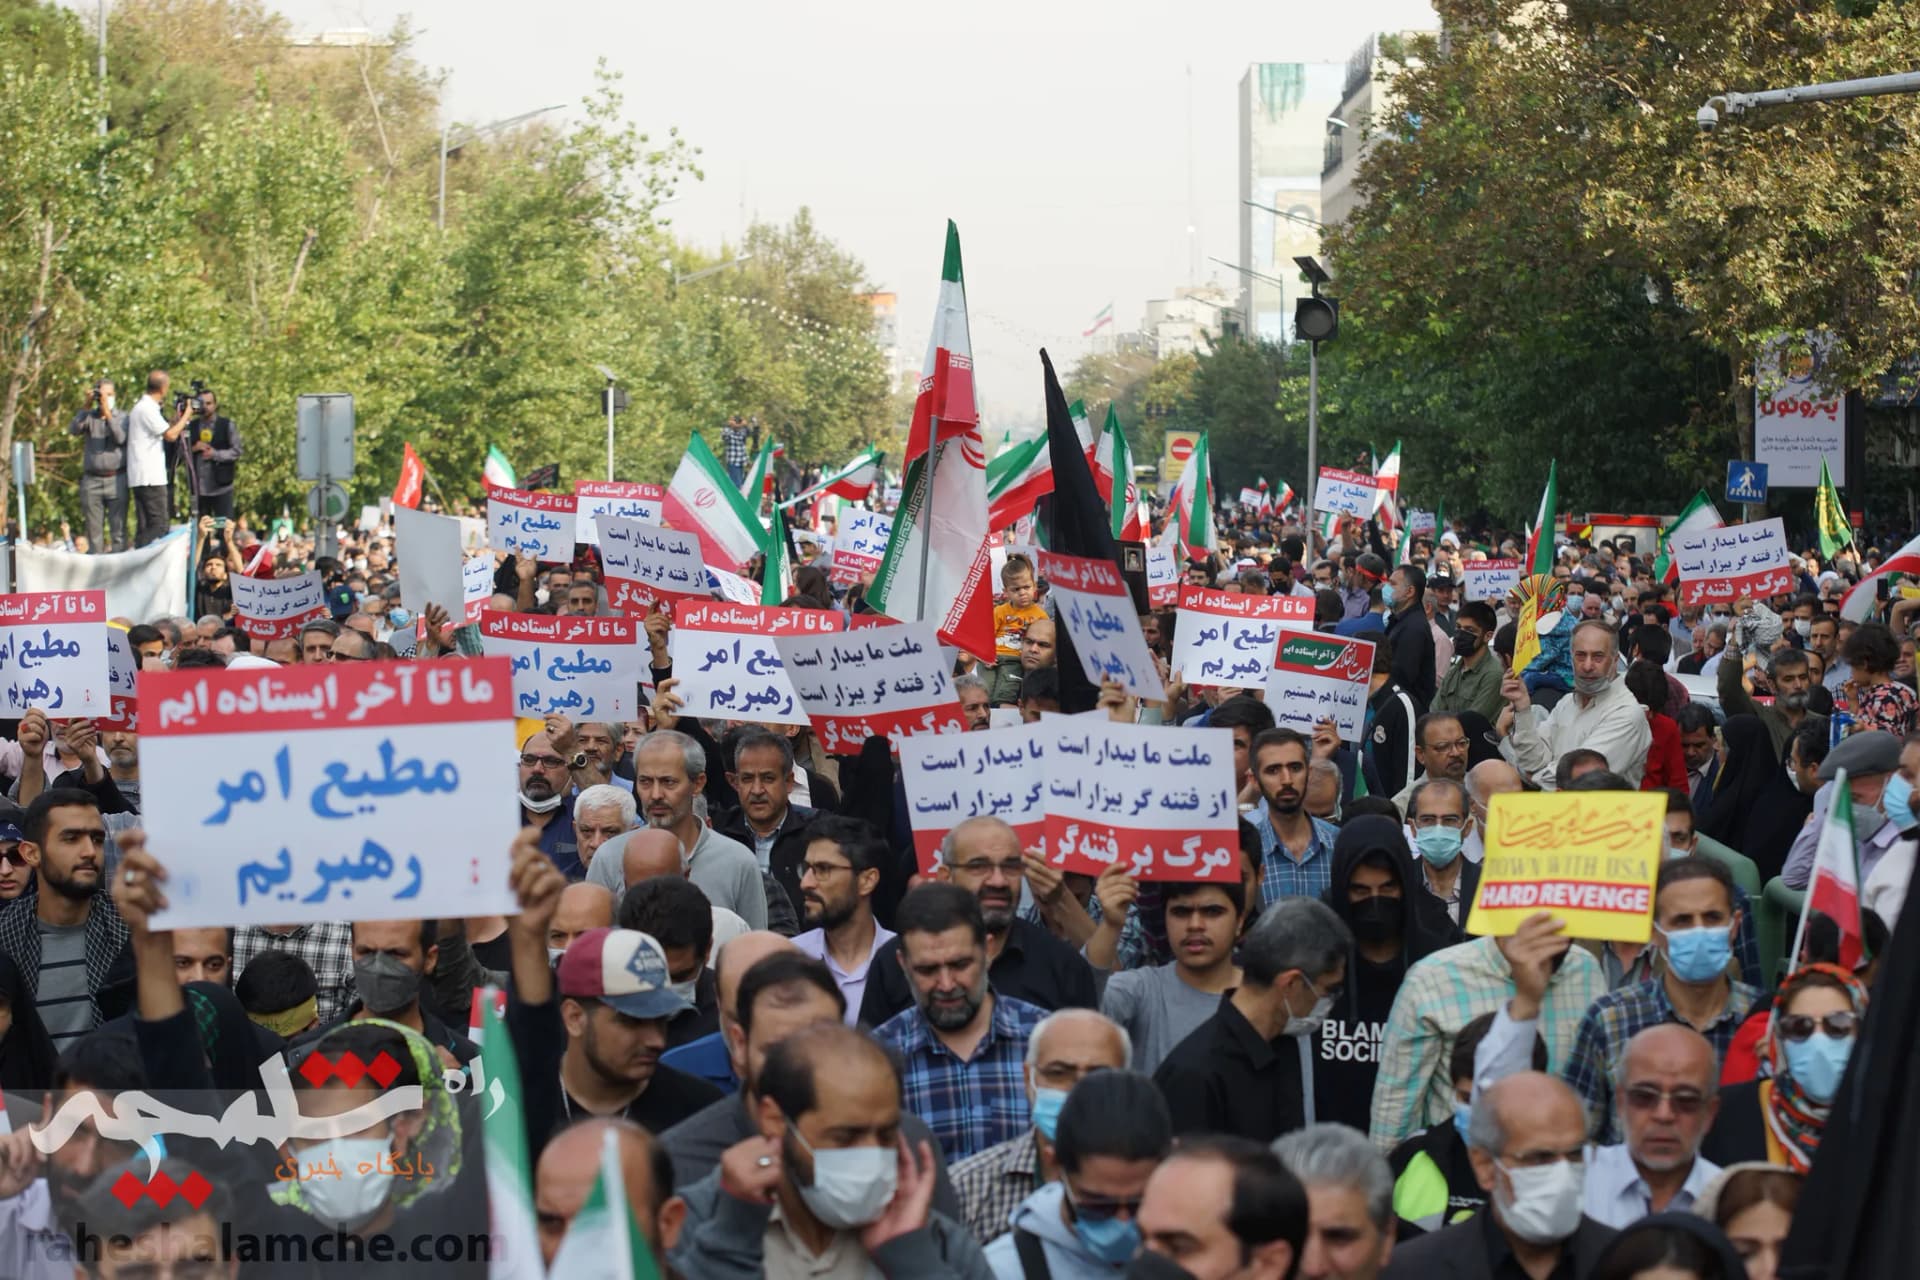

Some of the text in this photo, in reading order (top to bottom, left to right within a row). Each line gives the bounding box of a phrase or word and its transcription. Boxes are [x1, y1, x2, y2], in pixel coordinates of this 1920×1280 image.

[534, 495, 554, 508] آخر
[498, 510, 561, 533] مطیع امر
[850, 515, 873, 530] امر
[608, 527, 691, 555] ملت ما بیدار است
[1684, 528, 1774, 551] ملت ما بیدار است
[606, 553, 703, 588] از فتنه گر بیزار است
[1682, 547, 1784, 573] از فتنه گر بیزار است
[1152, 586, 1177, 601] مرگ
[1755, 572, 1788, 594] مرگ
[31, 594, 96, 621] ما تا آخر
[685, 606, 708, 627] ایم
[1185, 592, 1308, 616] ما تا آخر ایستاده ایم
[490, 616, 628, 641] ما تا آخر ایستاده ایم
[711, 608, 765, 629] ایستاده
[768, 611, 801, 632] آخر
[804, 614, 816, 630] تا
[820, 614, 834, 631] ما
[1086, 600, 1125, 641] مطیع
[19, 628, 81, 669] مطیع
[1192, 621, 1275, 650] طیع امر
[547, 648, 612, 681] مطیع
[697, 639, 741, 672] امر
[792, 636, 922, 671] ملت ما بیدار است
[159, 665, 494, 729] ما تا آخر ایستاده ایم
[519, 689, 595, 715] رهبریم
[710, 684, 794, 715] رهبریم
[799, 670, 946, 707] از فتنه گر بیزار است
[1283, 686, 1316, 700] هستیم
[1280, 710, 1313, 723] هستیم
[921, 747, 965, 771] است
[973, 745, 1023, 775] بیدار
[1058, 735, 1212, 768] ملت ما بیدار است
[202, 738, 459, 825] مطیع امر
[915, 780, 1043, 816] گر بیزار است
[1050, 779, 1227, 817] از فتنه گر بیزار است
[1126, 835, 1231, 877] مرگ بر
[1606, 855, 1650, 881] USA
[236, 838, 423, 905] رهبریم
[1480, 883, 1650, 911] HARD REVENGE
